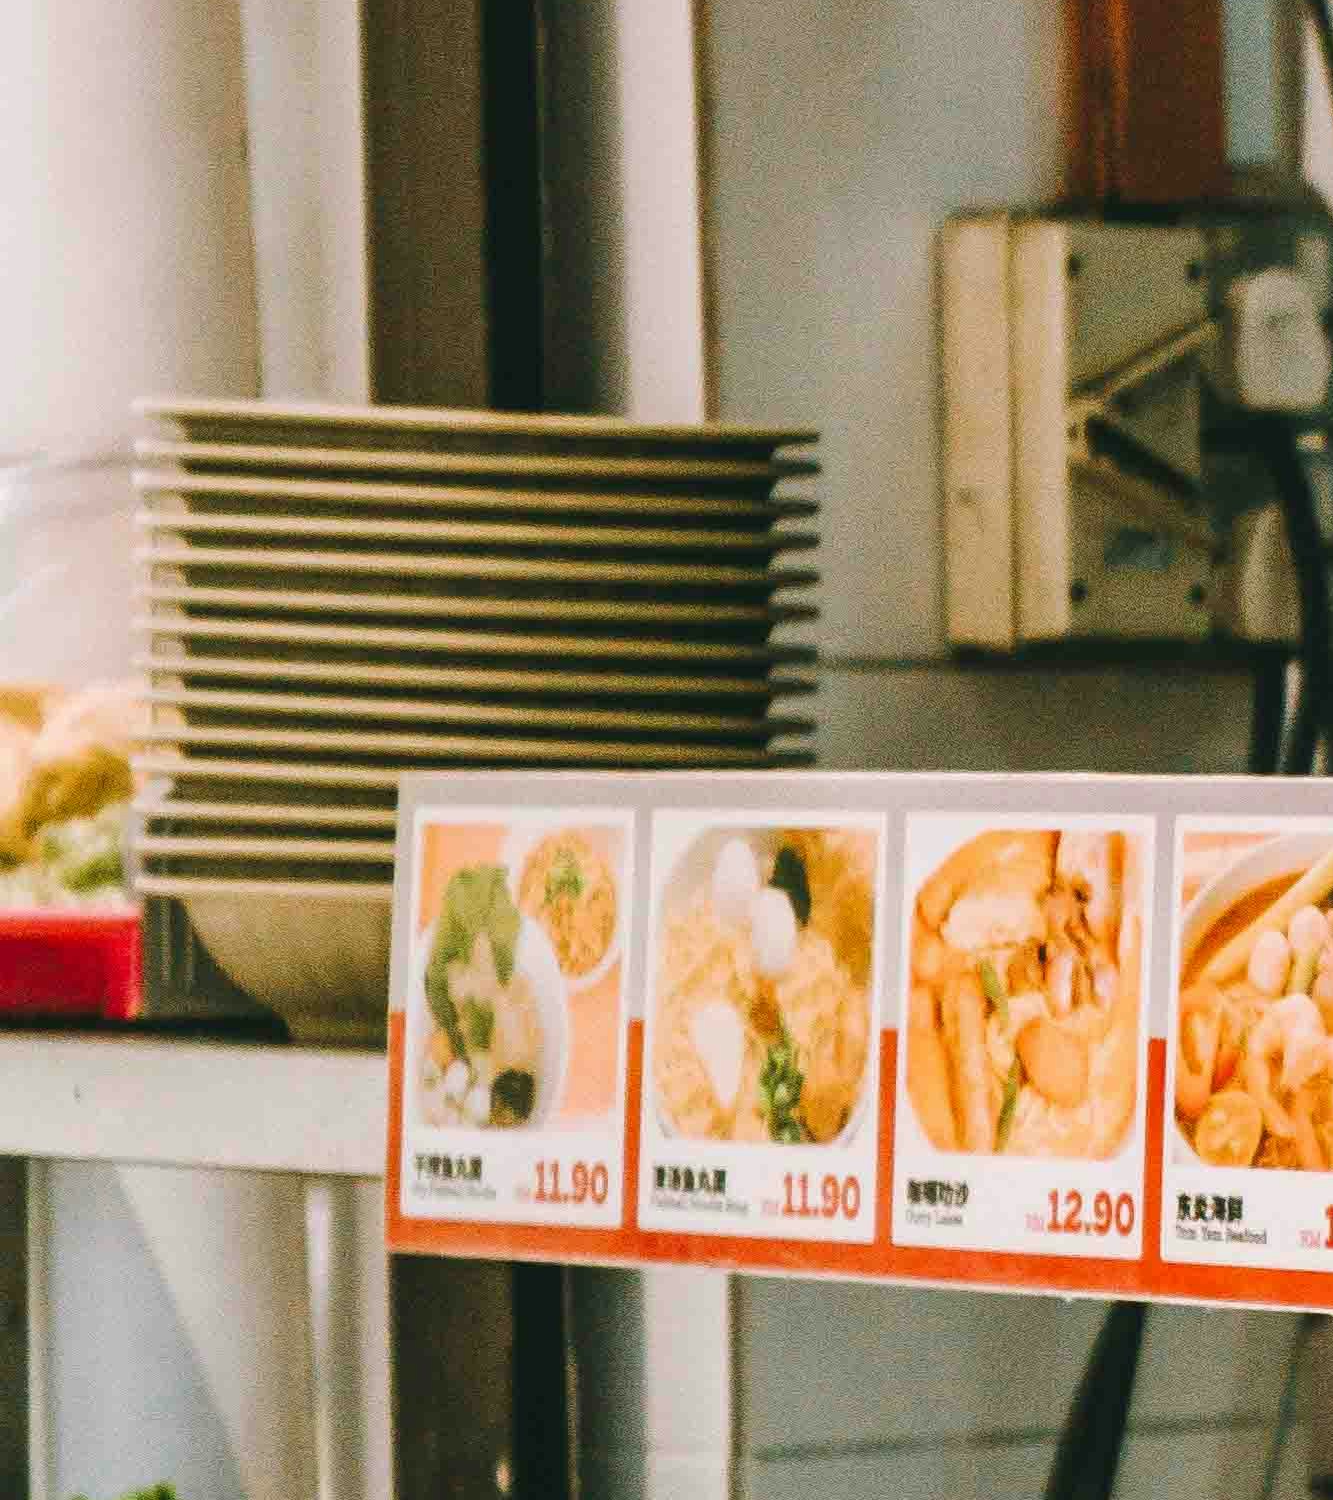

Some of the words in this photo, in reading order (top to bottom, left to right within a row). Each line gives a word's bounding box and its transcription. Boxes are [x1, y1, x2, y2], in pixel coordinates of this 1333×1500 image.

[534, 1160, 609, 1206] 11.90
[782, 1172, 861, 1222] 11.90
[1047, 1188, 1135, 1237] 12.90
